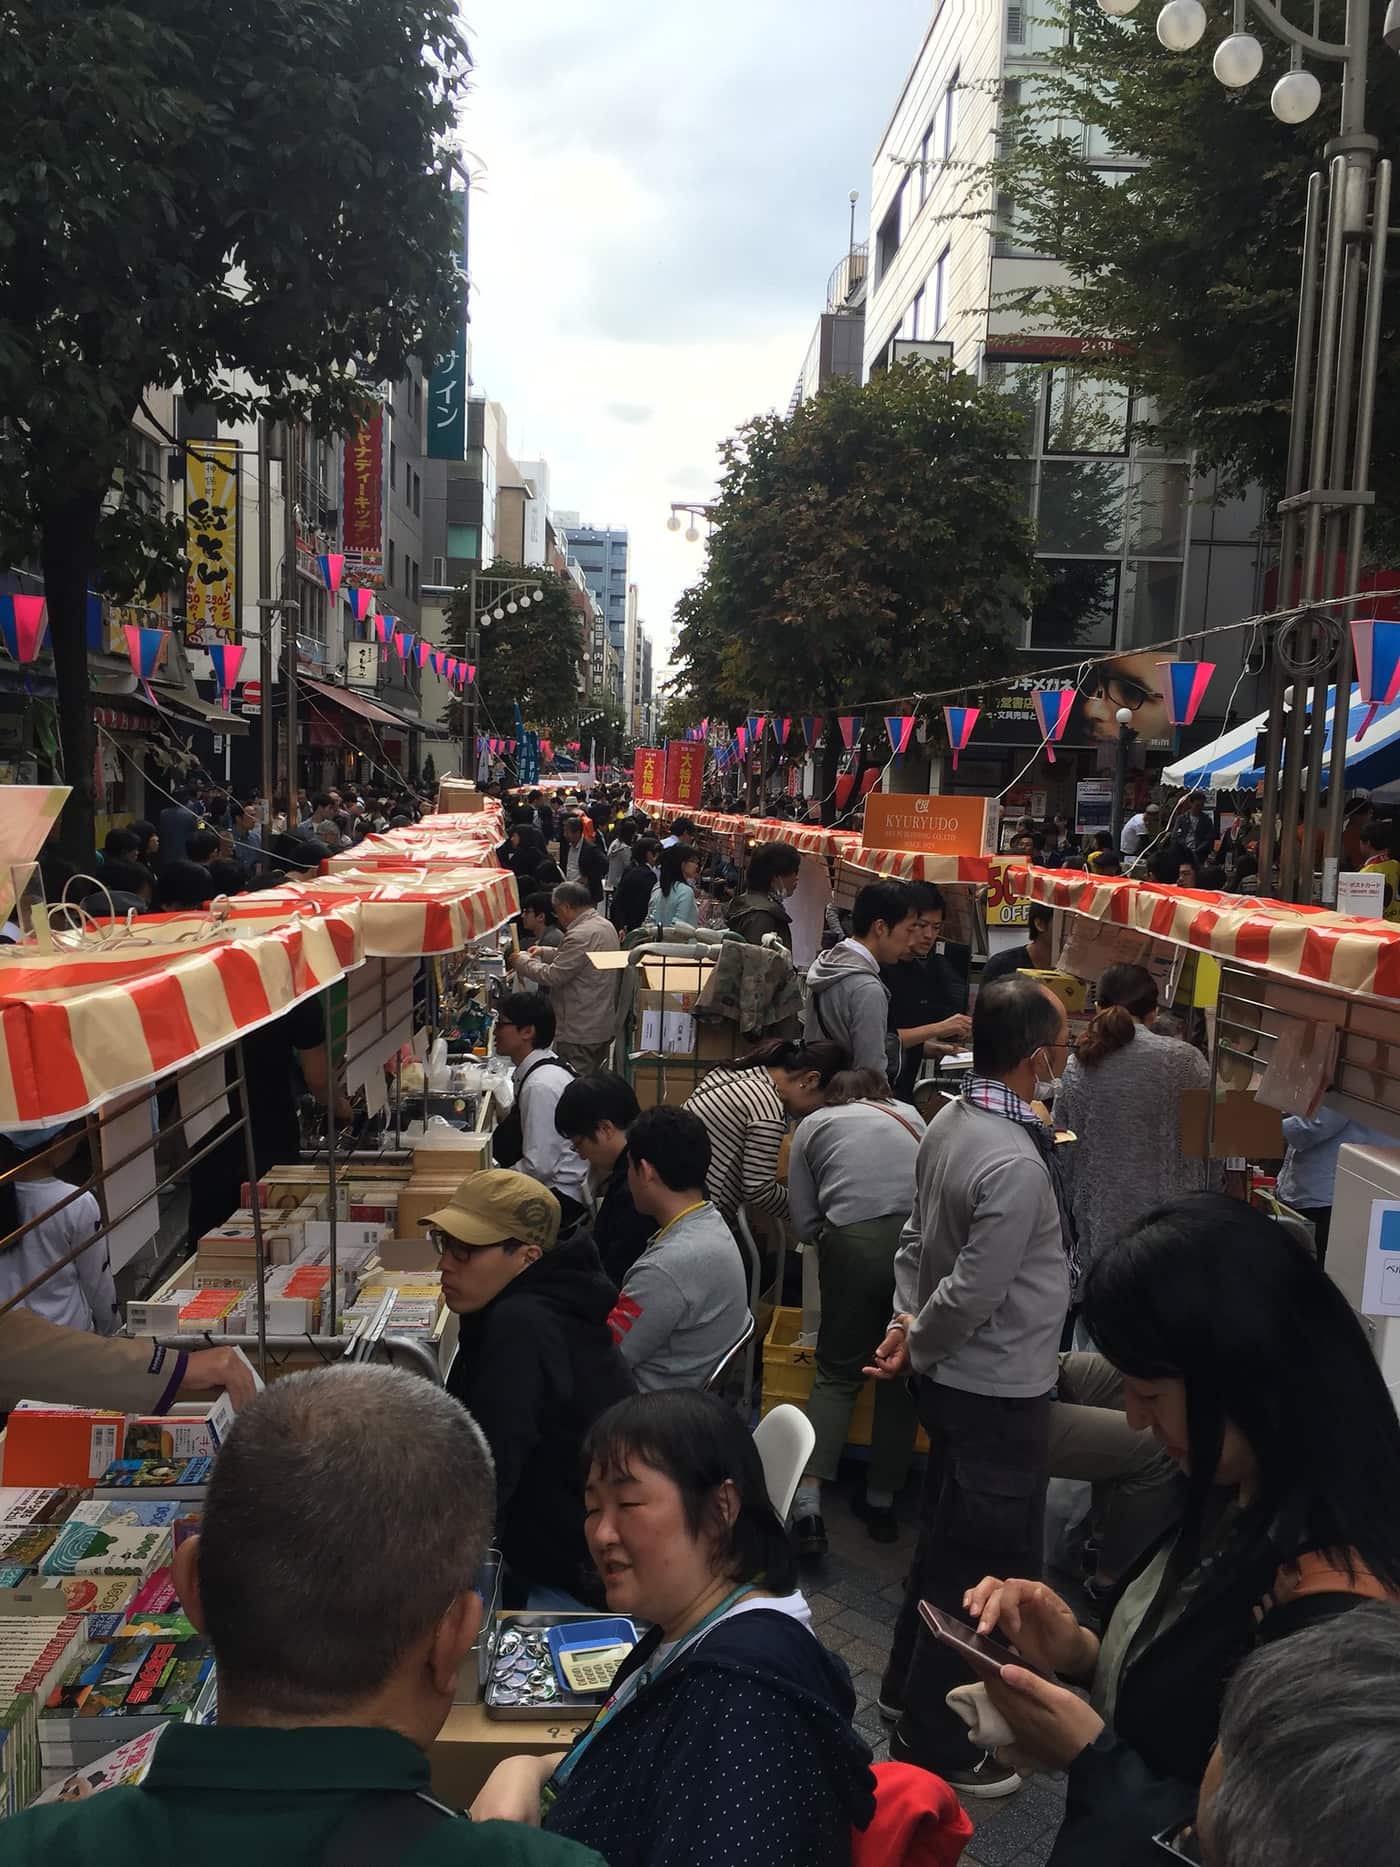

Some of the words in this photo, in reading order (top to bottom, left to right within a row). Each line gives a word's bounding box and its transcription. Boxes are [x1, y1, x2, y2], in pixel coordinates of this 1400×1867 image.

[641, 757, 655, 795] 大特価
[678, 752, 694, 799] 大特価
[885, 814, 959, 832] KYURYUDO
[1000, 905, 1032, 923] OFF
